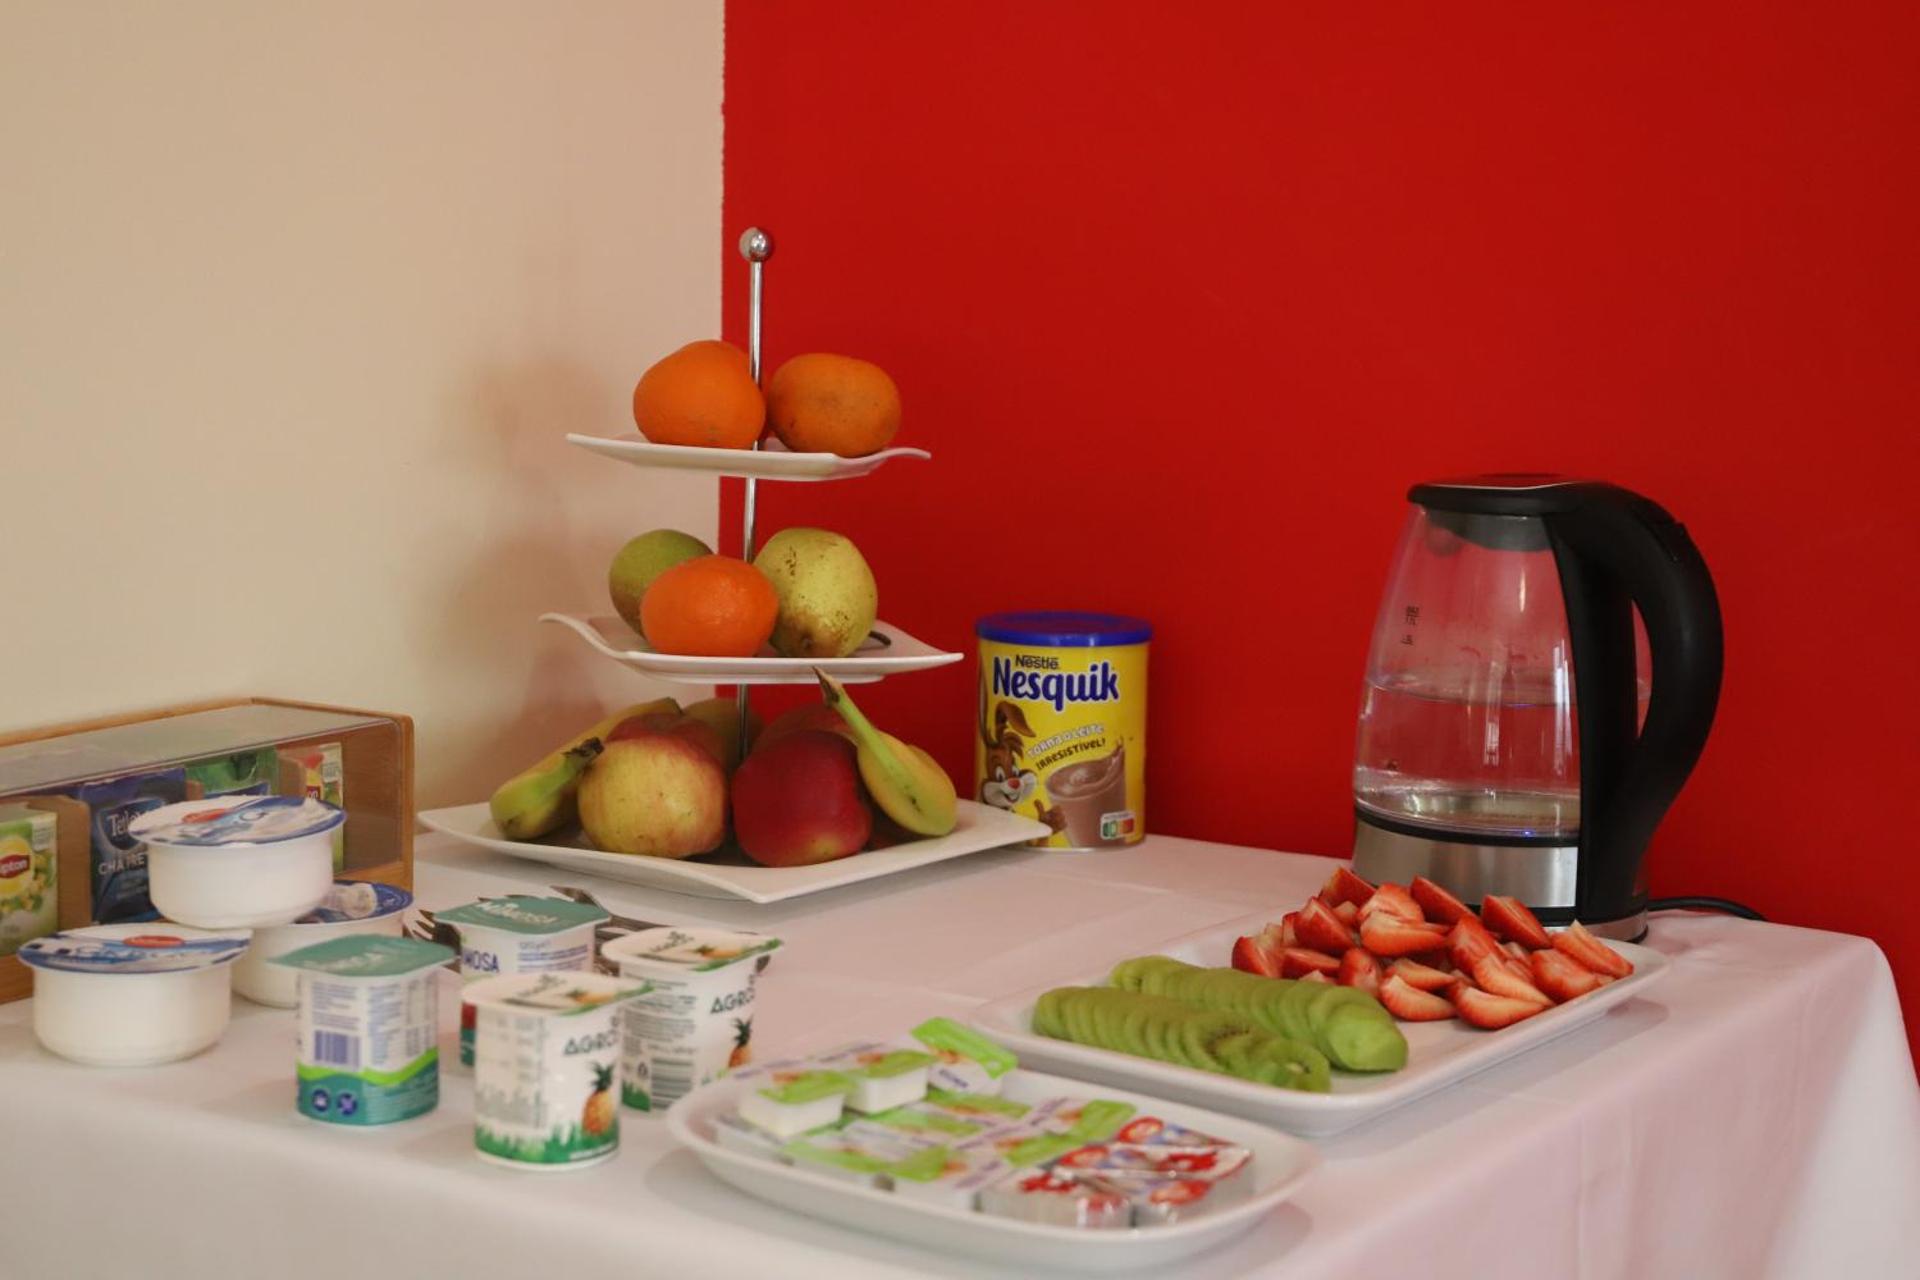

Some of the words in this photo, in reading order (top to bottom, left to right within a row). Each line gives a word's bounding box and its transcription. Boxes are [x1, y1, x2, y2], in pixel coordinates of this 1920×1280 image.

[993, 656, 1119, 712] Nesquik
[0, 859, 28, 875] pton
[126, 852, 145, 868] PRE
[710, 987, 756, 1014] AGRO
[562, 1029, 617, 1056] AGRO
